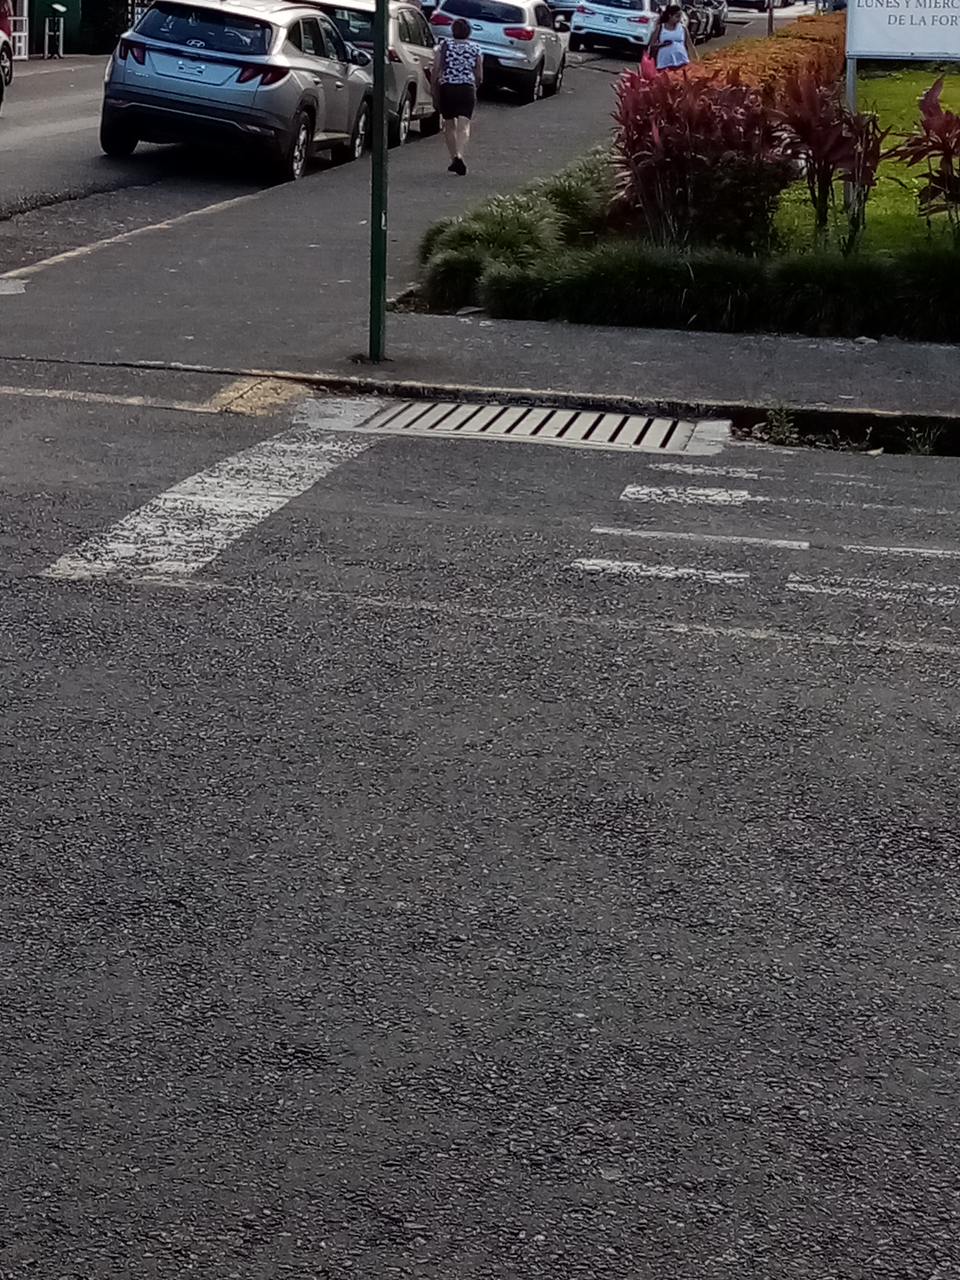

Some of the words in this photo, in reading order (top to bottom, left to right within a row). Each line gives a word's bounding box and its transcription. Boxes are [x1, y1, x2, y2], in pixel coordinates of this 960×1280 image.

[888, 15, 906, 25] DE
[910, 15, 929, 26] LA
[931, 15, 960, 26] FOR
